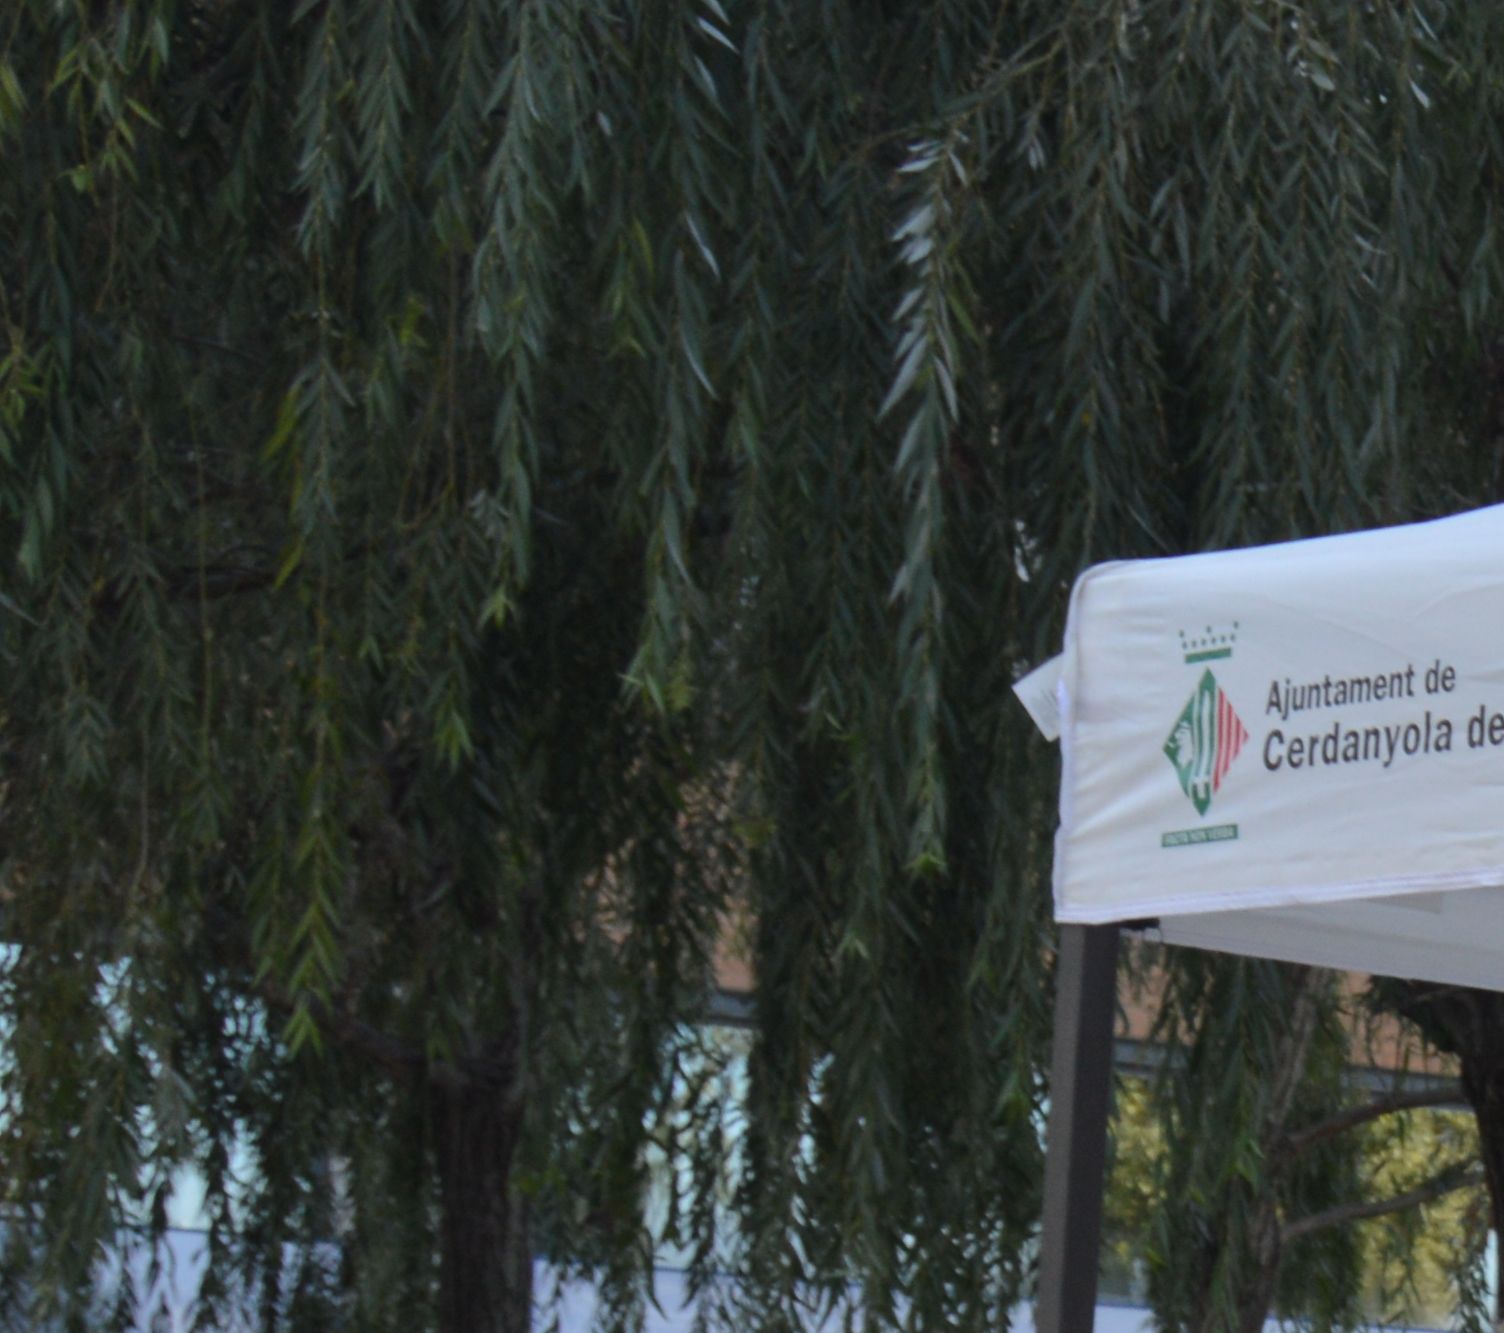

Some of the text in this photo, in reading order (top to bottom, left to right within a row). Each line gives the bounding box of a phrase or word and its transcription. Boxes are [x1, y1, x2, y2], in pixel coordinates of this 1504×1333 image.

[1265, 660, 1456, 717] Ajuntament de
[1262, 709, 1452, 773] Cerdanyola
